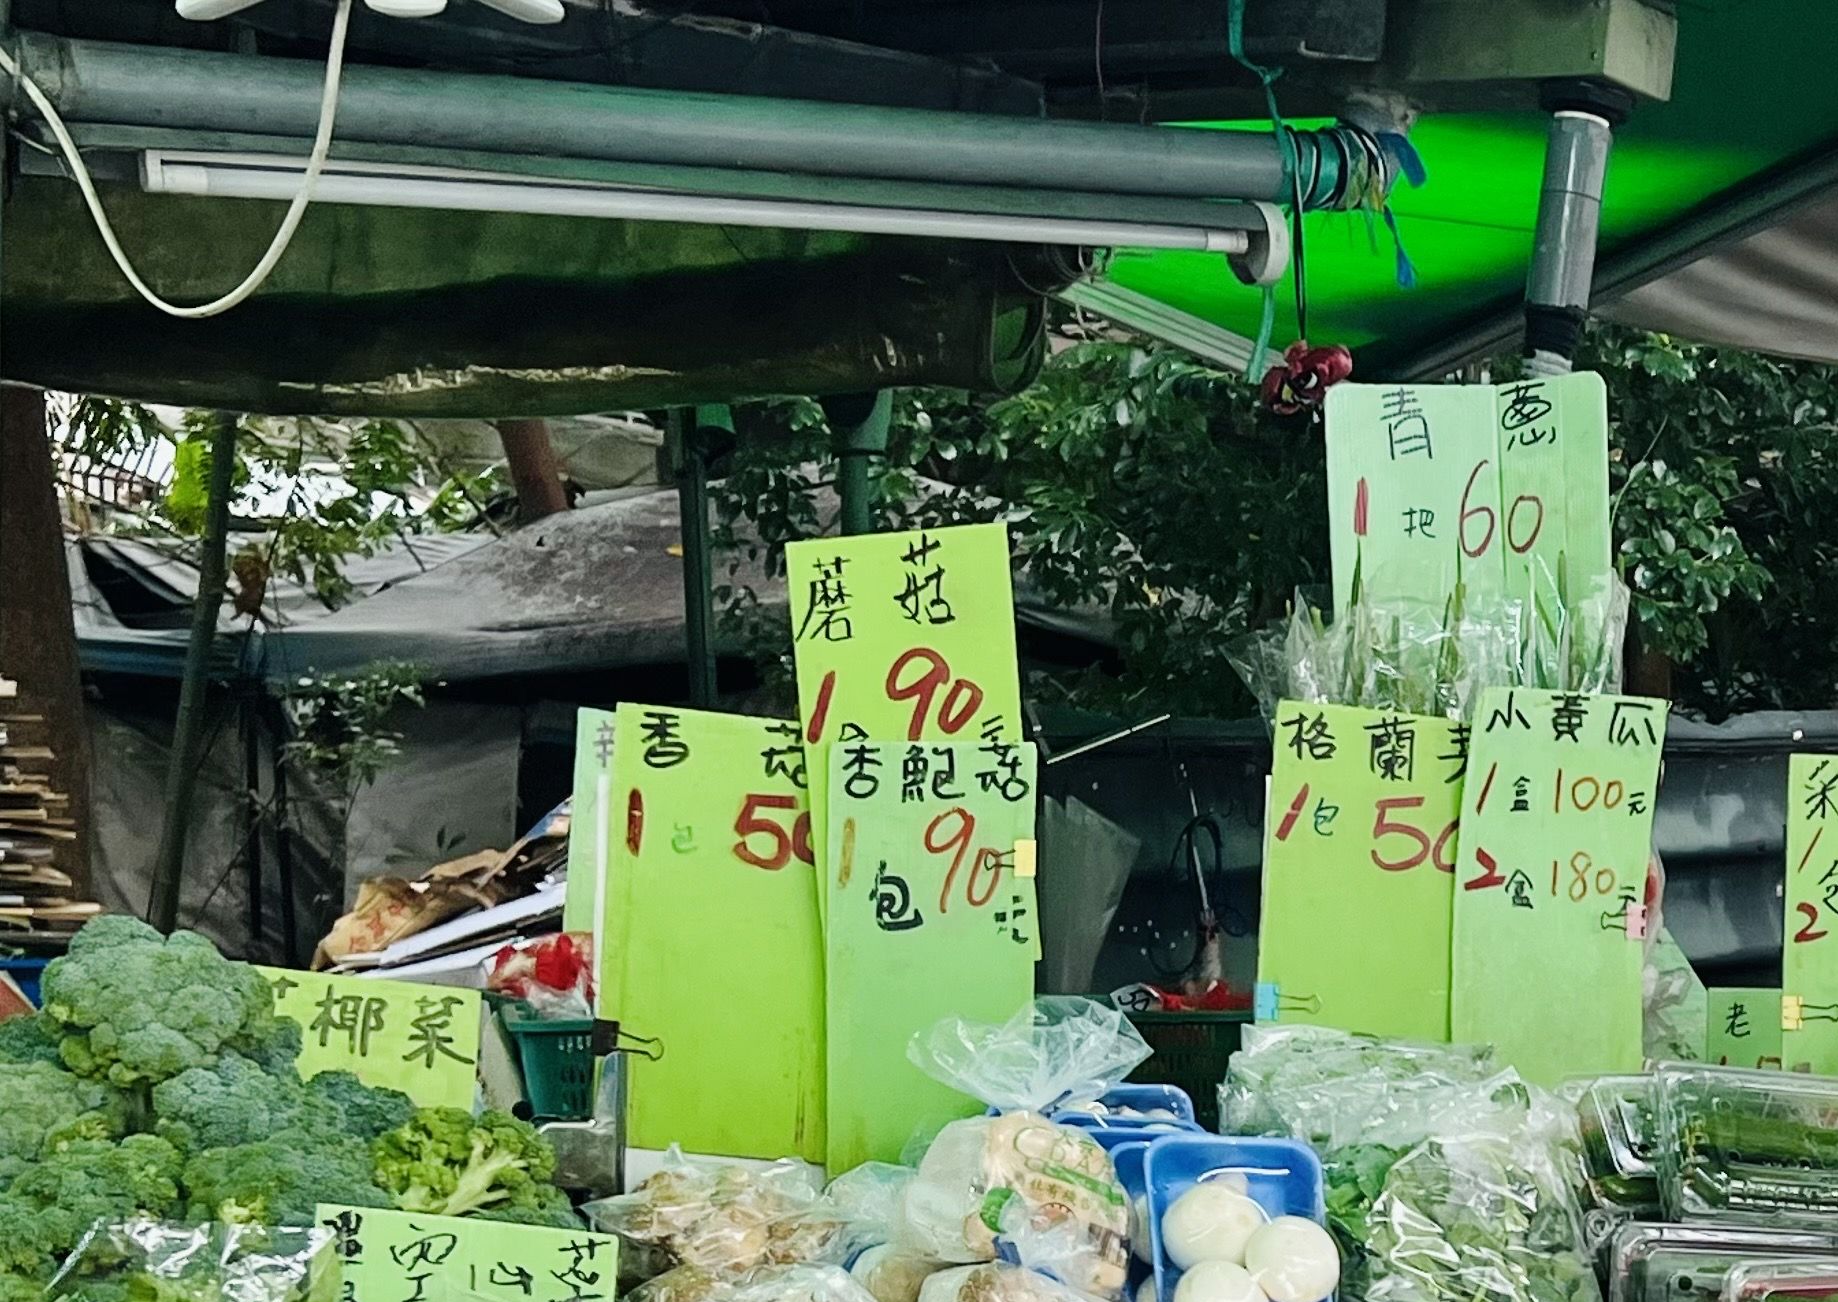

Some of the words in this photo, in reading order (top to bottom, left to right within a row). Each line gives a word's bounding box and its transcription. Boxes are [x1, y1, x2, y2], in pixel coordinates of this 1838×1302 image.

[795, 534, 956, 642] 蘑菇
[1486, 690, 1658, 746] 小黃瓜
[842, 743, 1030, 804] 杏鮑菇
[272, 975, 475, 1069] 椰菜
